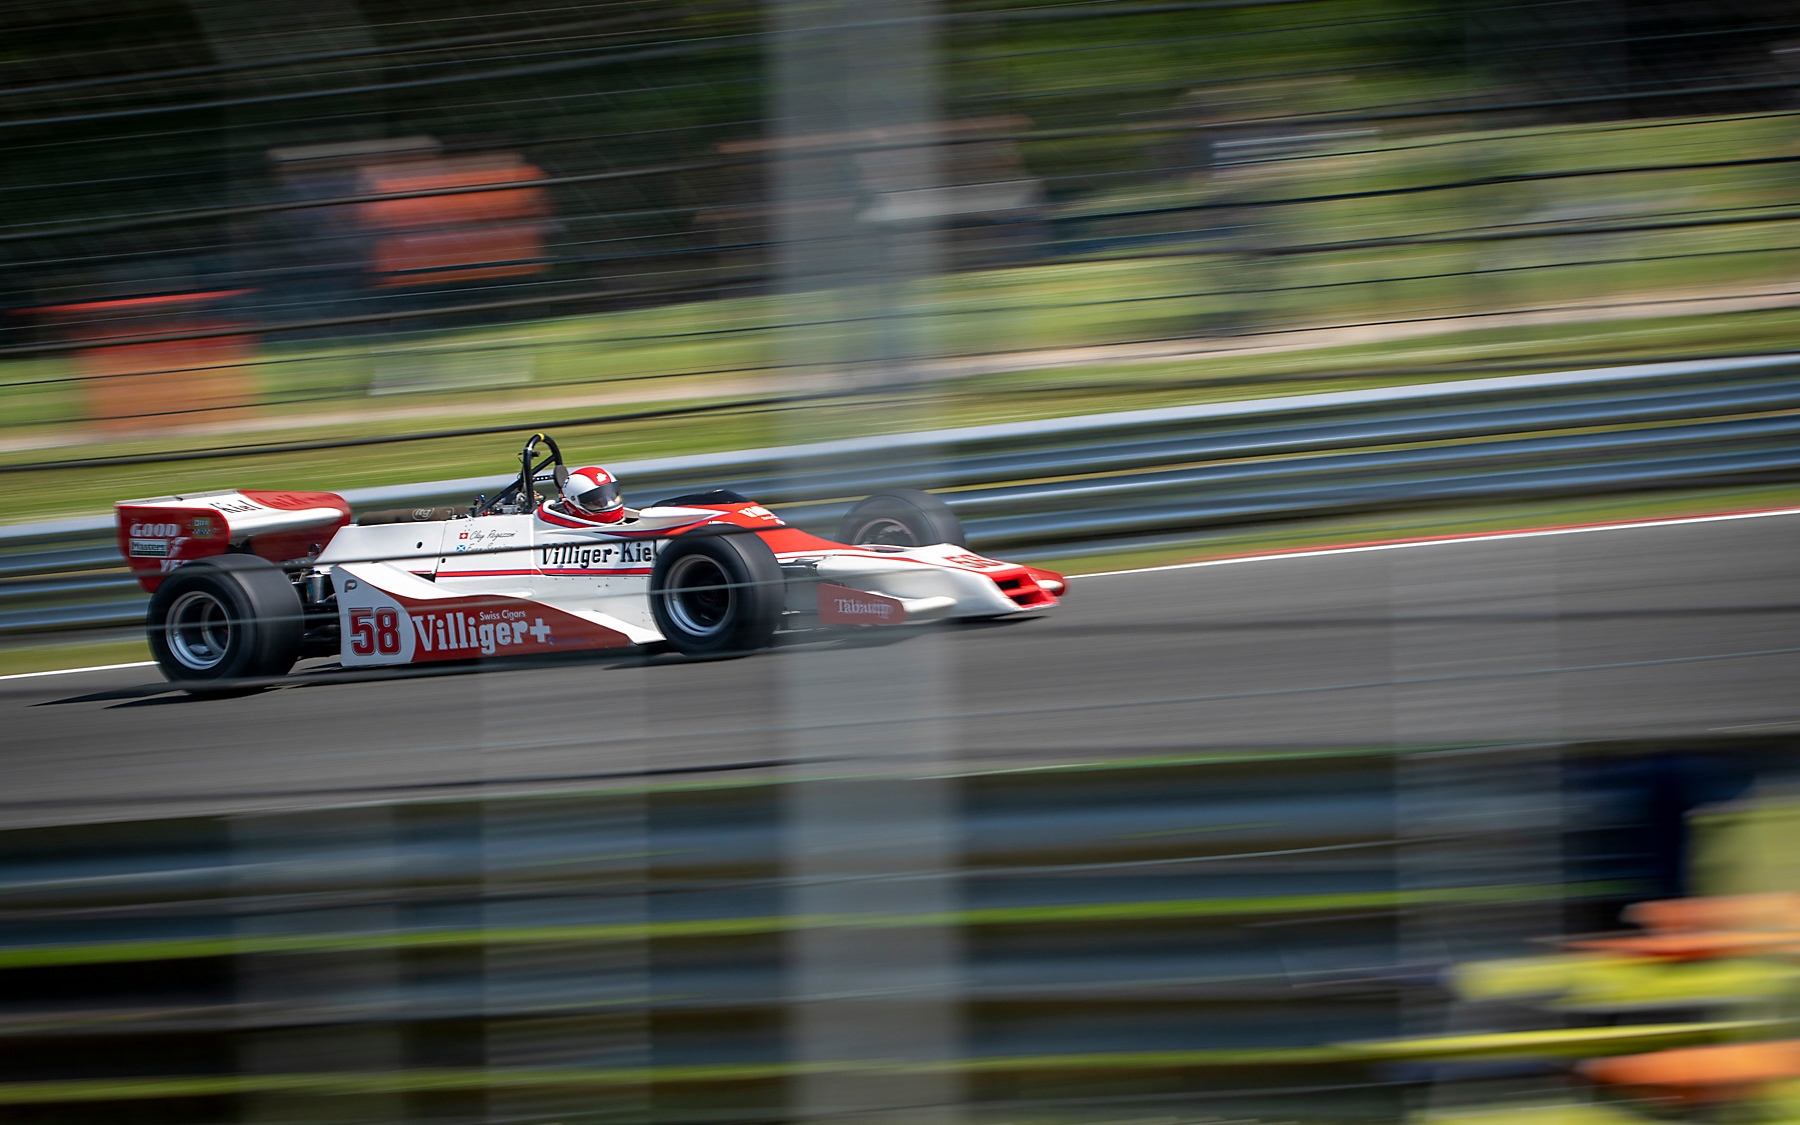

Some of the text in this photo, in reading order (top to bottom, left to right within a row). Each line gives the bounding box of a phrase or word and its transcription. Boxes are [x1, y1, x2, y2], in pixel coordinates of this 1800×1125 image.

[129, 523, 181, 537] GOOD
[479, 609, 526, 621] Swiss Cigars
[348, 606, 402, 656] 58
